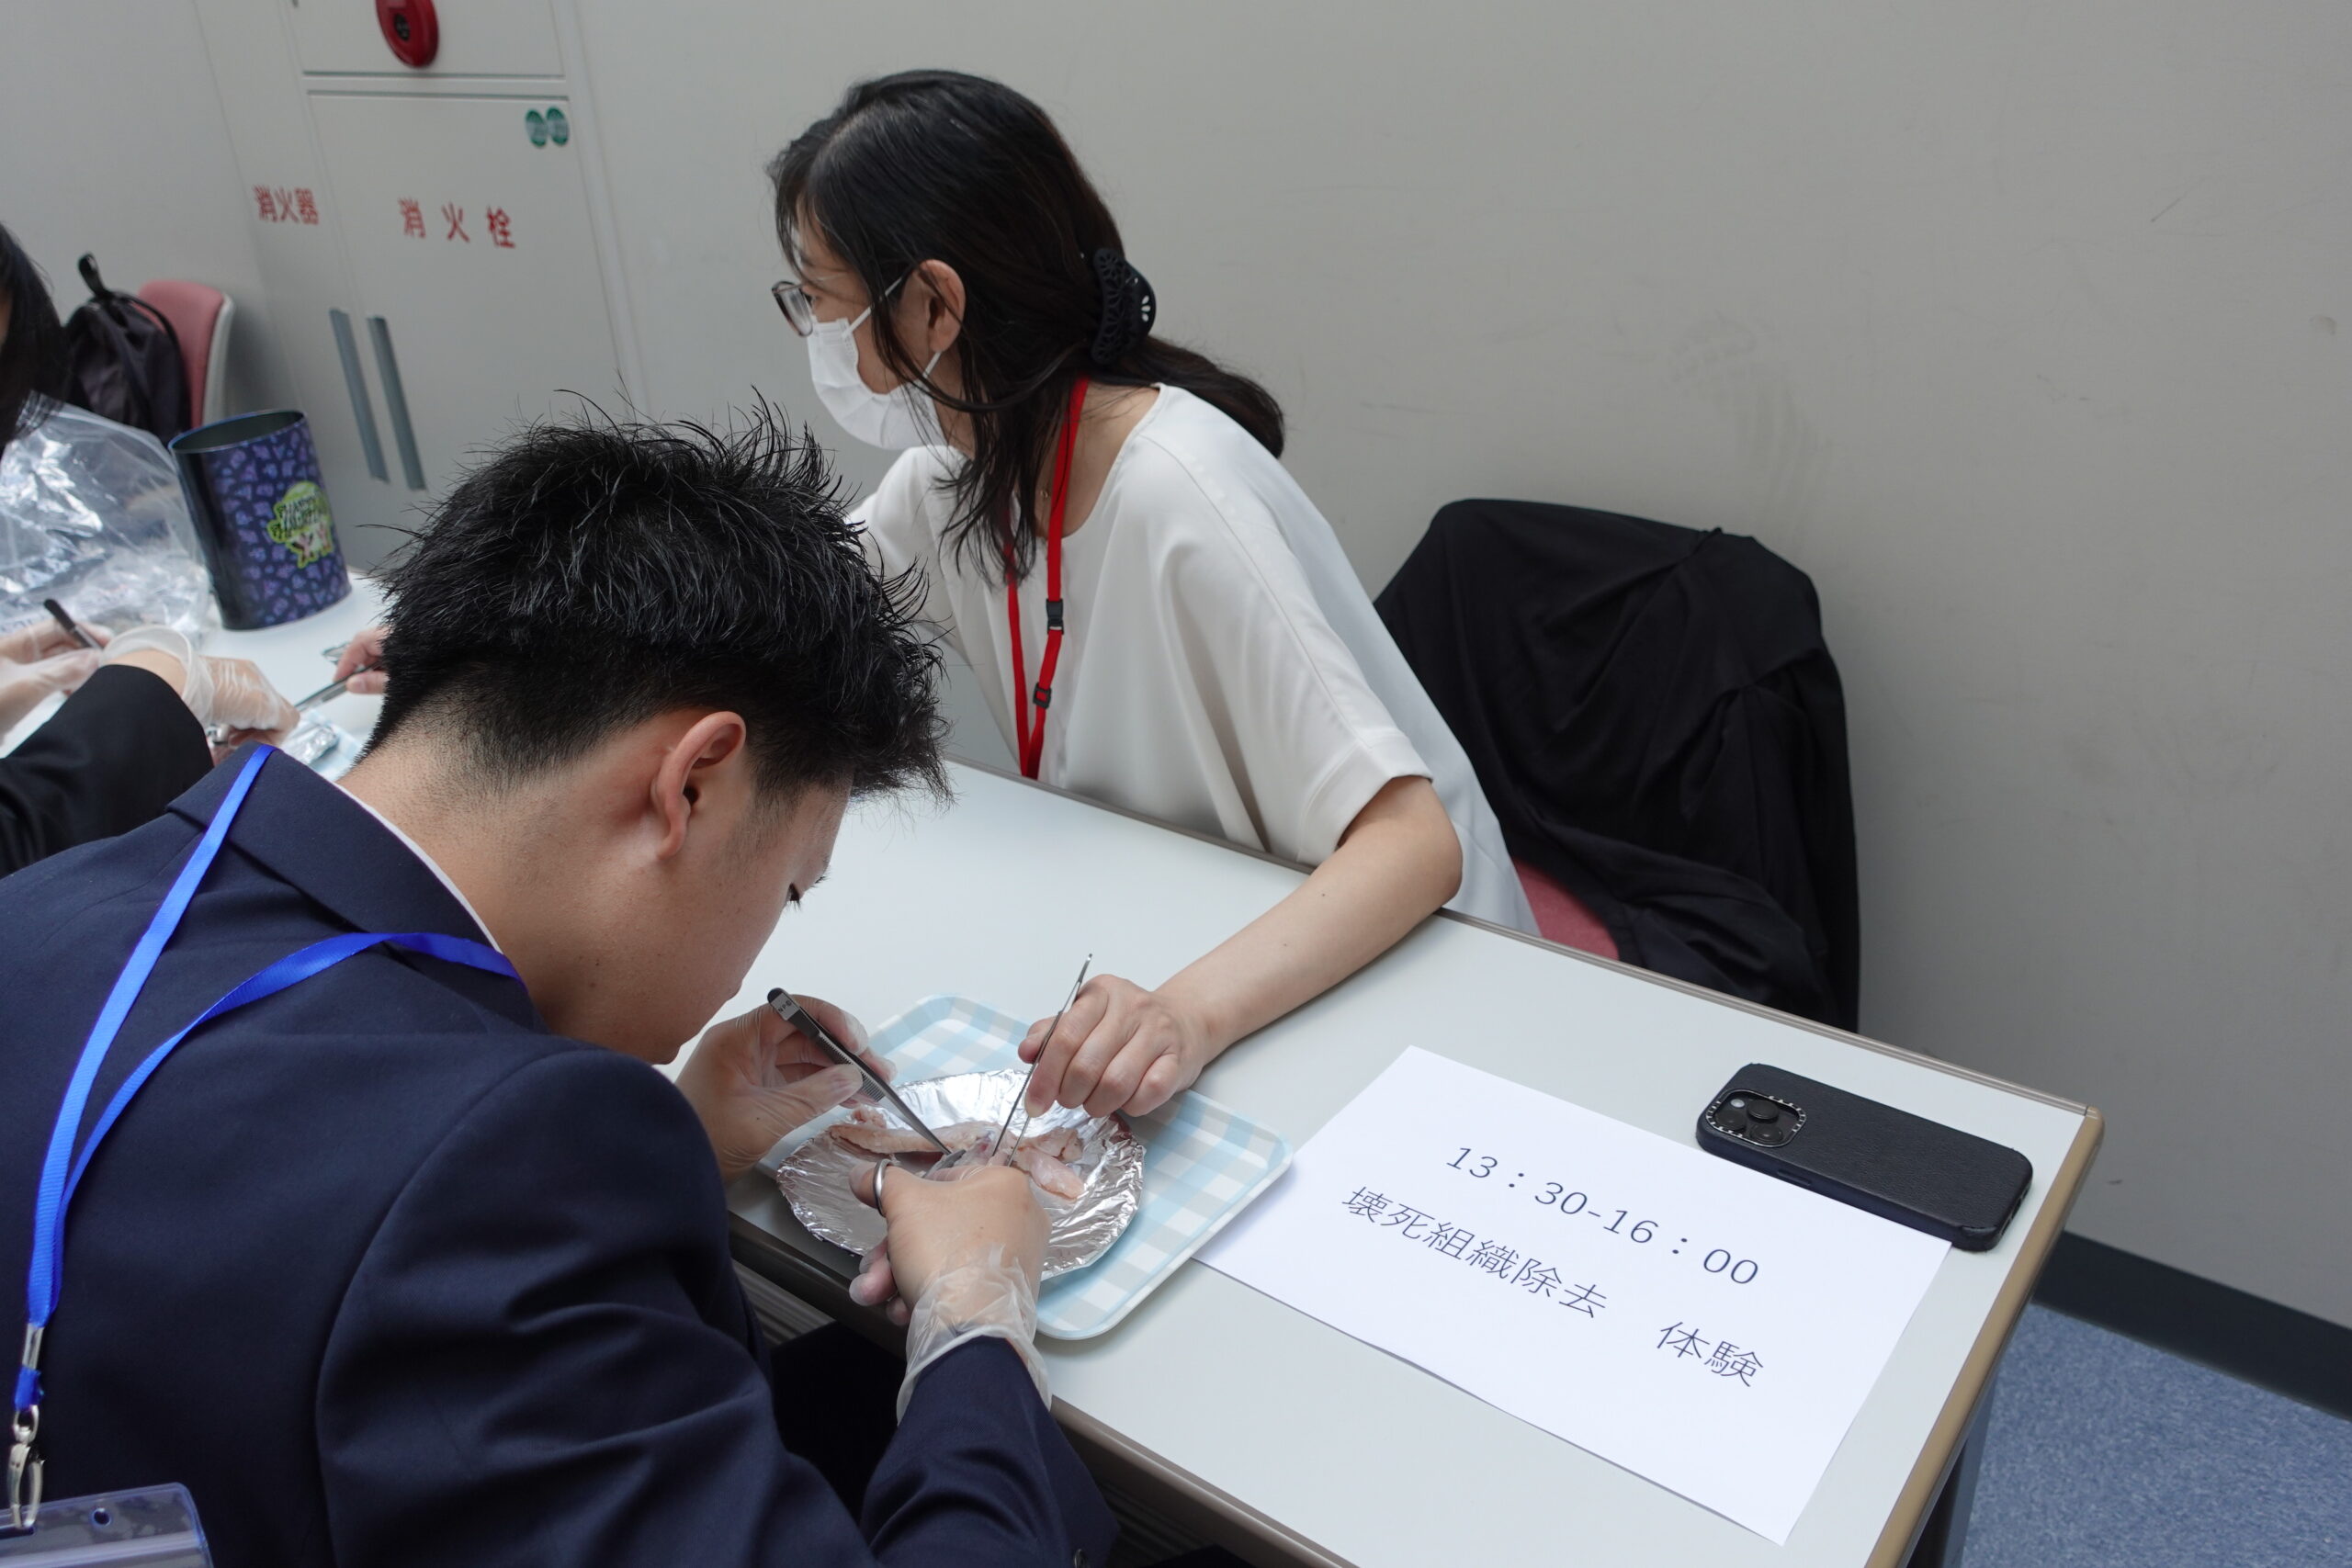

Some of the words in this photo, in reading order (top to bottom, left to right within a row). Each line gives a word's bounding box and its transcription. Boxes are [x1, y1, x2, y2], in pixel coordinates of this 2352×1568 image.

[254, 185, 319, 225] 消火器
[399, 197, 515, 248] 消火栓
[1341, 1186, 1608, 1319] 壊死組織除去
[1657, 1321, 1764, 1388] 体験
